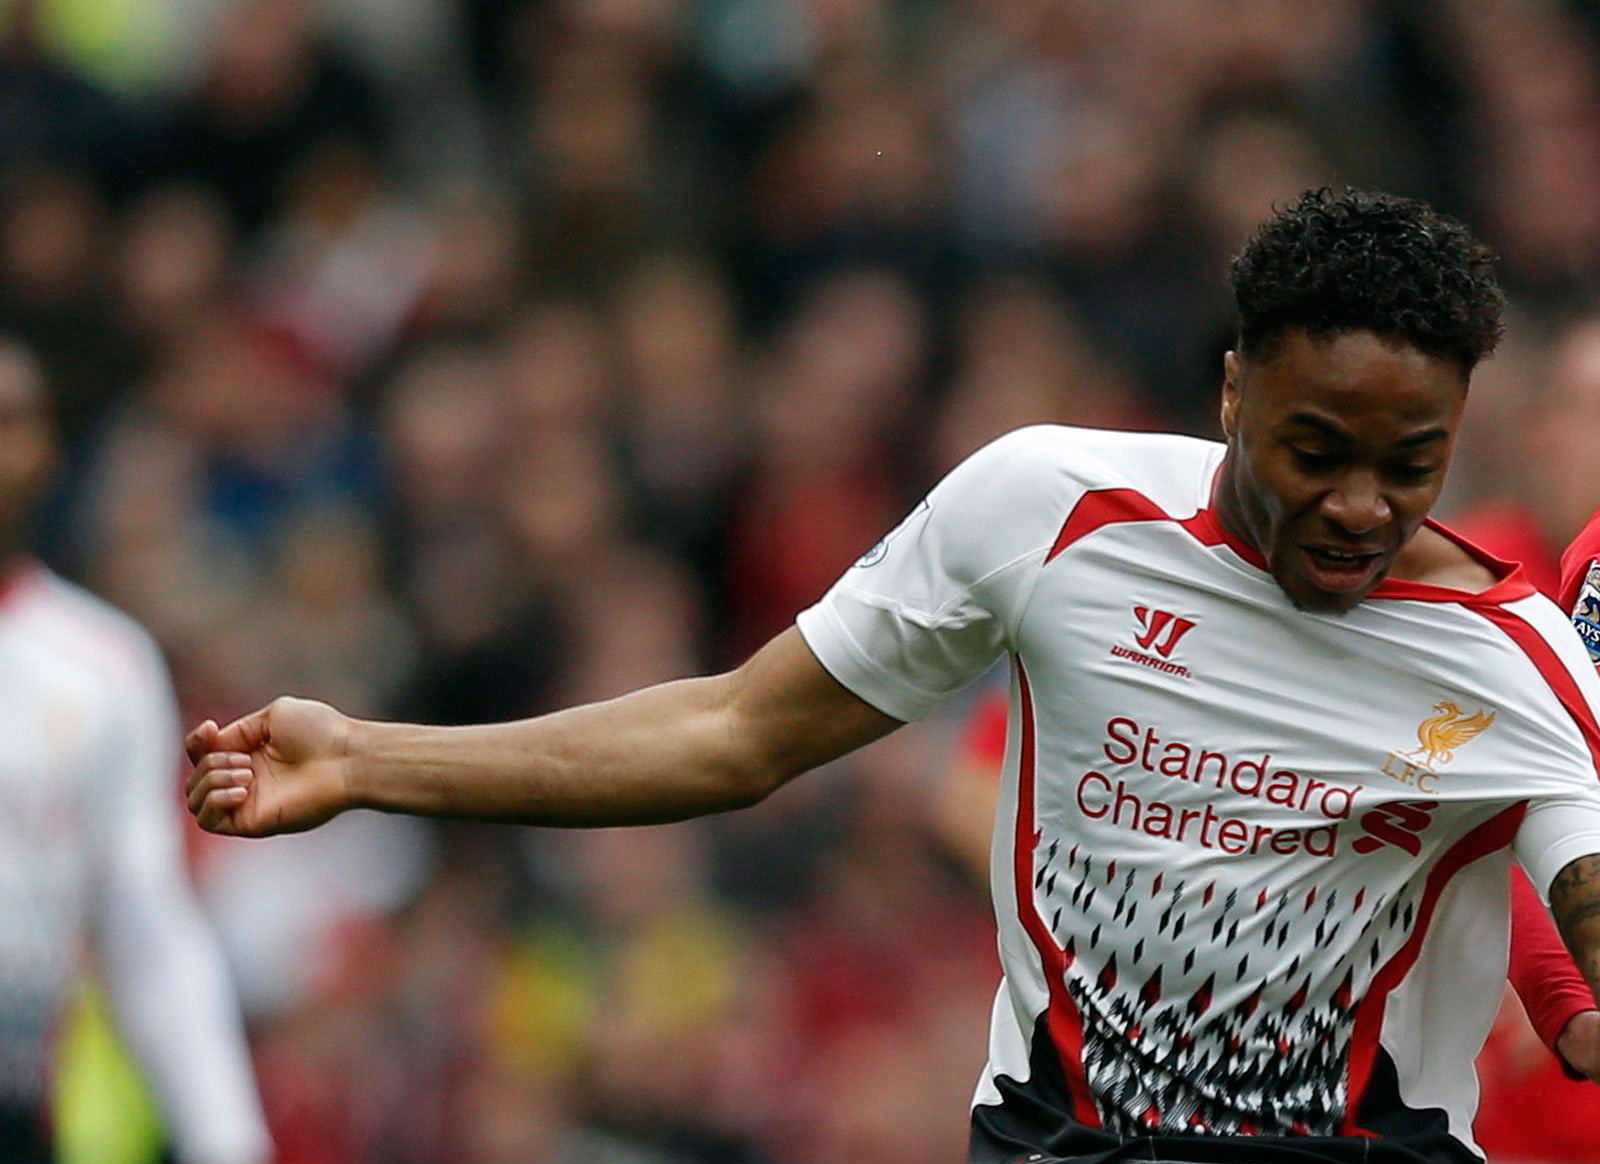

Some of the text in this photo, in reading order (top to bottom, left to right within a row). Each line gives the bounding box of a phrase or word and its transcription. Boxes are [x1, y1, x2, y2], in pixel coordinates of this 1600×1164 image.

[1110, 645, 1190, 677] WARRIOR
[1103, 716, 1364, 821] Standard
[1076, 771, 1339, 858] Chartered
